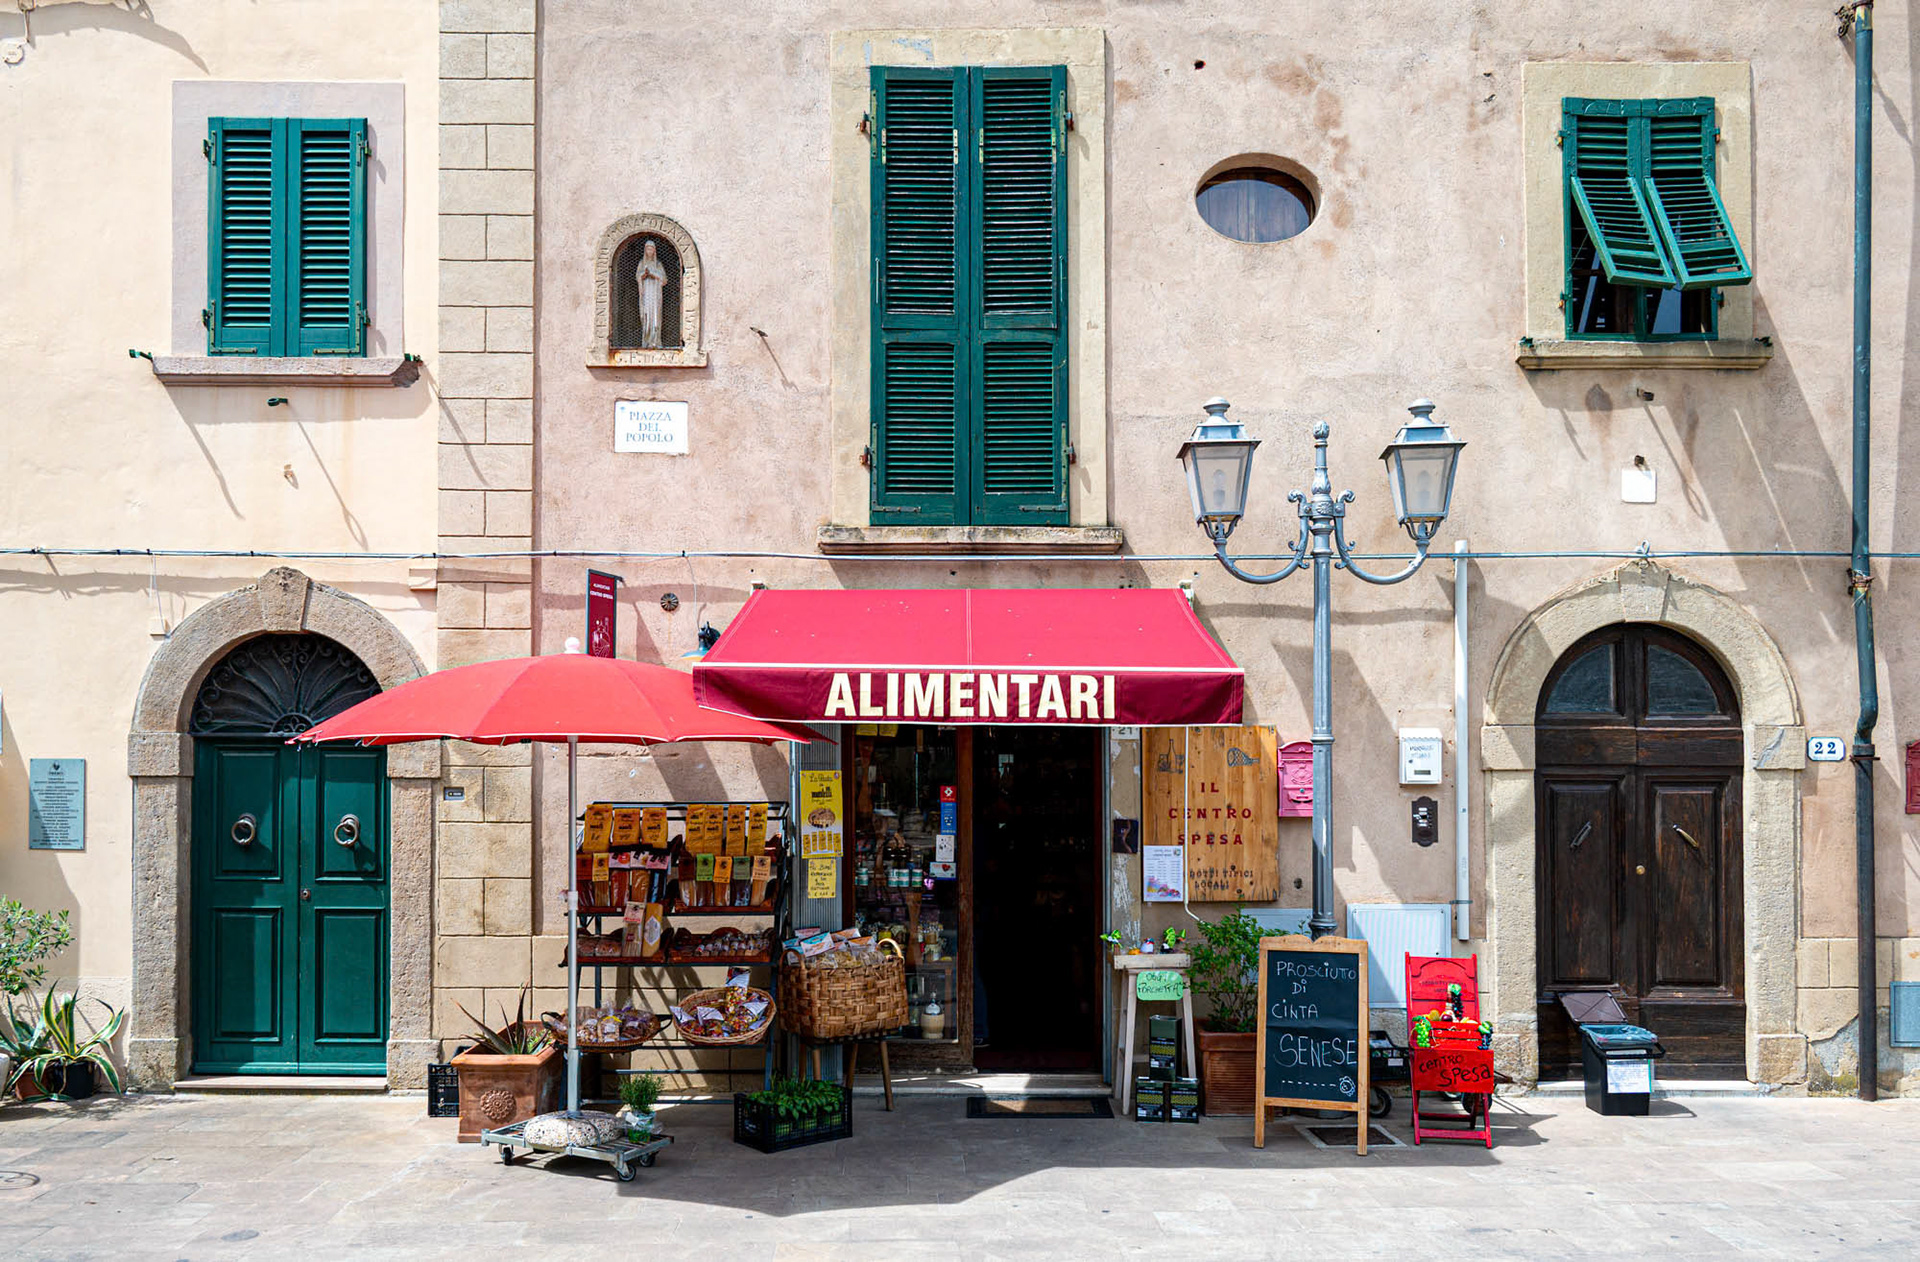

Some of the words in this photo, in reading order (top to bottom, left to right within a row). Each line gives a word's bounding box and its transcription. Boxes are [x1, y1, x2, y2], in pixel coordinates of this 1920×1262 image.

[629, 411, 672, 421] PIAZZA
[639, 422, 662, 432] DEL
[626, 433, 674, 443] POPOLO
[824, 672, 1116, 719] ALIMENTARI
[1814, 741, 1837, 755] 22
[1200, 782, 1220, 793] IL
[1168, 807, 1252, 819] CENTRO
[1177, 833, 1243, 846] SPESA
[1194, 879, 1230, 890] LOCALI
[1273, 1033, 1358, 1068] SENESE
